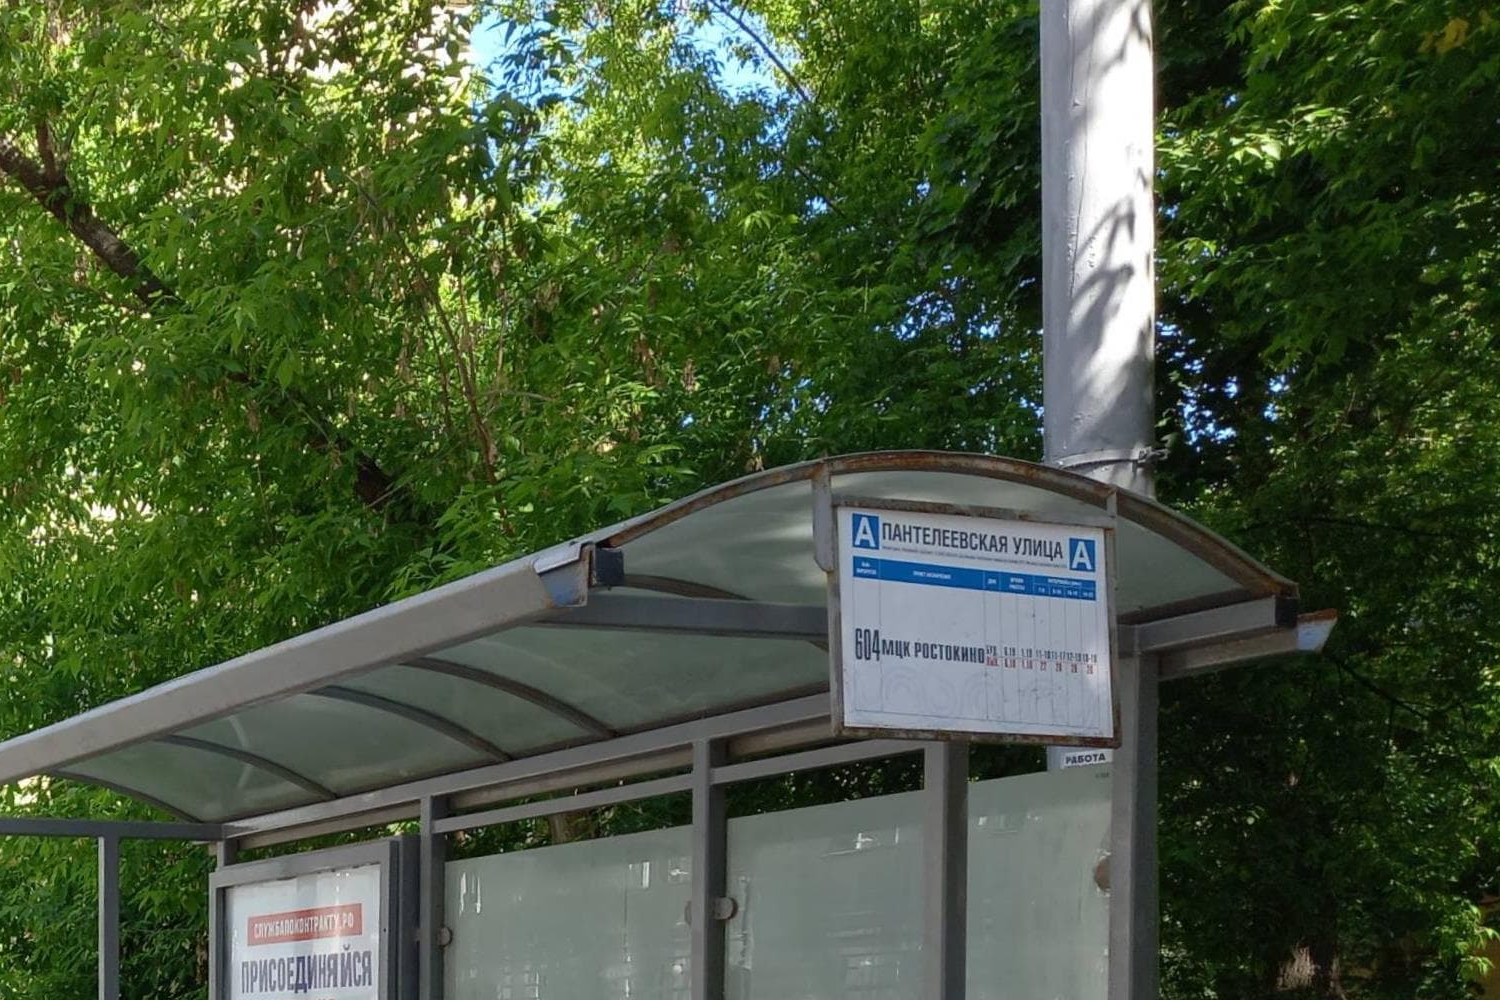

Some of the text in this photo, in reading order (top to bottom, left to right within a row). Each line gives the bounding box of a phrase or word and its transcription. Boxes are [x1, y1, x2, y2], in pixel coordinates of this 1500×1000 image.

[882, 522, 1008, 553] ПАНТЕЛЕЕВСКАЯ
[1013, 537, 1063, 561] УЛИЦА
[855, 628, 880, 661] 604
[881, 638, 910, 659] МЦК
[914, 642, 984, 663] РОСТОКИНО
[1065, 753, 1106, 764] РАБОТА
[253, 912, 354, 938] СЛУЖБАПОКОНТРАКТУ.РФ
[241, 944, 372, 994] ПРИСОЕДИНЯЙСЯ
